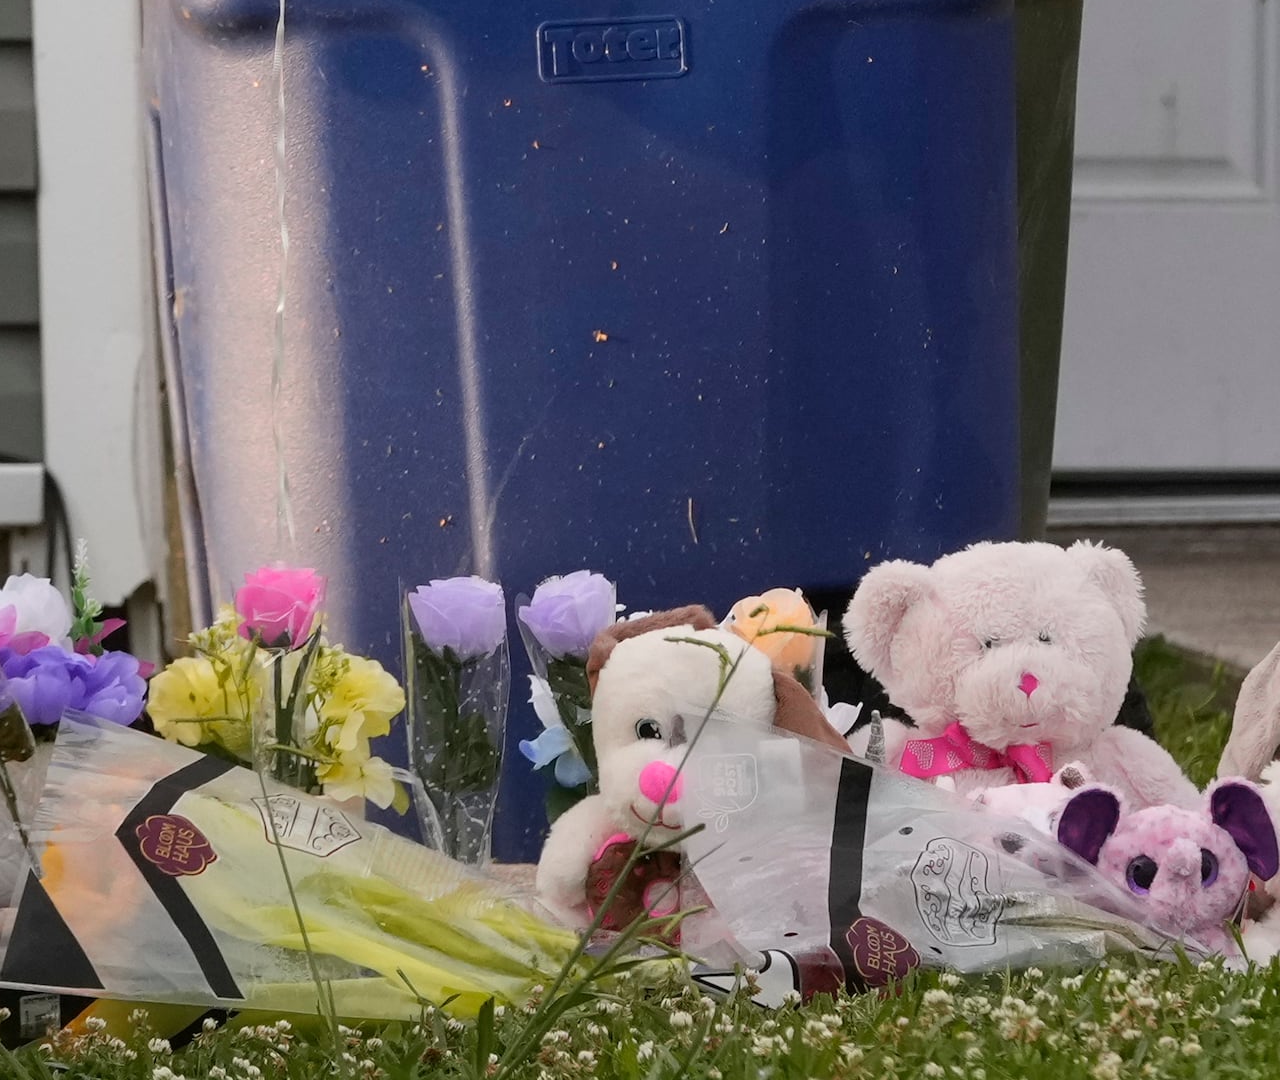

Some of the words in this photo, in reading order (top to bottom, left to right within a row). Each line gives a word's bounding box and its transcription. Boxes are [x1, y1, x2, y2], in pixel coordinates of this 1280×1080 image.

[155, 822, 177, 858] BLOOM
[172, 828, 195, 864] HAUS
[866, 924, 881, 970] BLOOM
[880, 931, 898, 975] HAUS
